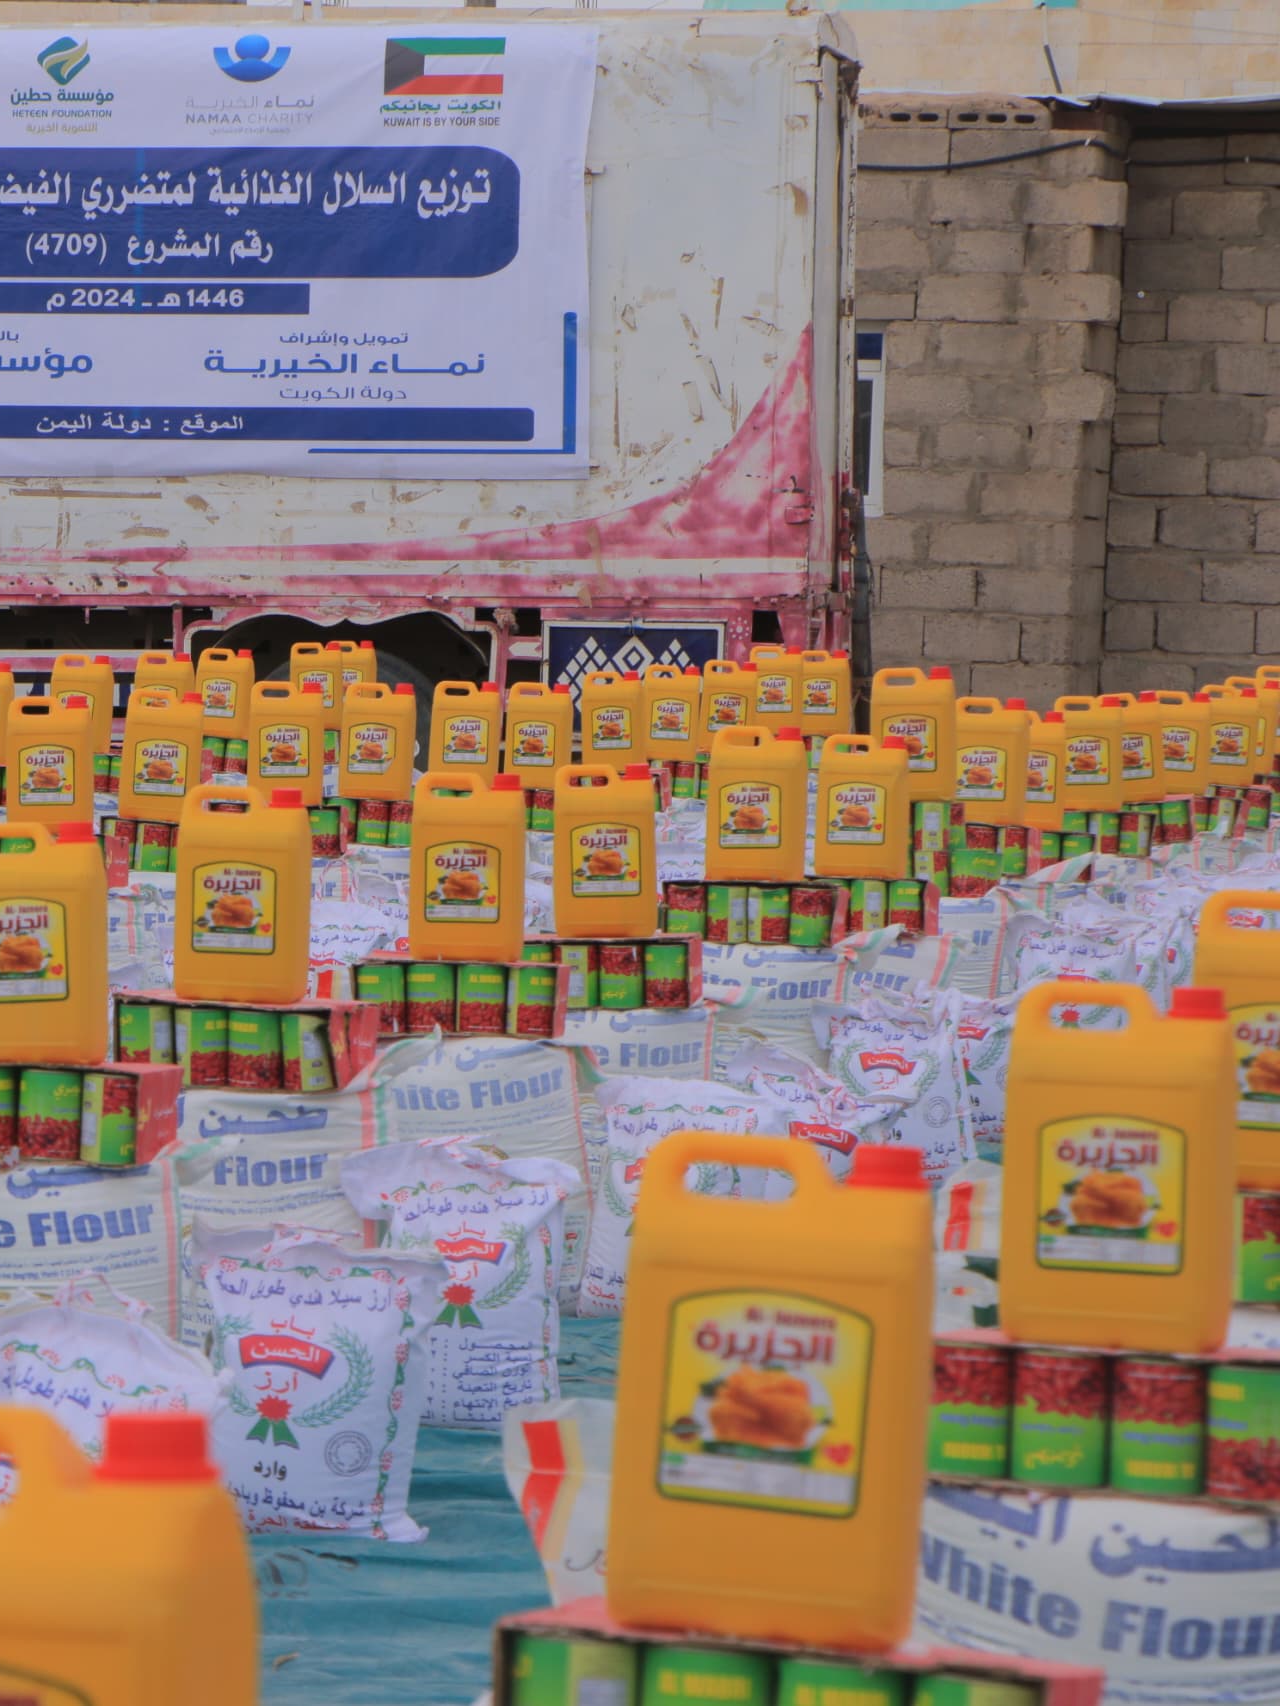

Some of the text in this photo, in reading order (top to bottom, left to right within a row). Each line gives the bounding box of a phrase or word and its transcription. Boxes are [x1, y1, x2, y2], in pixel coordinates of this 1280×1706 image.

[10, 87, 115, 106] مؤسسة حطين
[379, 99, 501, 115] الكويت بجانبكم
[12, 109, 113, 118] HETEEN FOUNDATION
[185, 113, 313, 125] NAMAA CHARITY
[383, 116, 499, 127] KUWAIT IS BY YOUR SIDE
[81, 171, 196, 220] لمتضرري
[208, 167, 312, 216] الغذائية
[323, 171, 406, 215] السلال
[418, 168, 491, 219] توزيع
[26, 228, 273, 265] رقم المشروع (4709)
[46, 293, 66, 311] م
[71, 288, 136, 308] 2024
[186, 289, 244, 308] 1446
[279, 329, 409, 347] تمويل وإشراف
[203, 346, 485, 380] نماء الخيرية
[279, 385, 408, 402] دولة الكويت
[36, 413, 92, 434] اليمن
[101, 411, 152, 434] دولة
[180, 413, 244, 436] الموقع
[265, 731, 300, 744] الجزيرة
[26, 755, 65, 767] الجزيرة
[961, 755, 997, 766] الجزيرة
[726, 792, 770, 806] الجزيرة
[835, 792, 876, 804] الجزيرة
[579, 835, 628, 850] الجزيرة
[434, 855, 488, 870] الجزيرة
[203, 876, 261, 893] الجزيرة
[620, 1040, 703, 1068] Flour
[470, 1066, 566, 1110] Flour
[796, 1127, 849, 1145] الحسن
[1056, 1140, 1160, 1170] الجزيرة
[214, 1153, 328, 1187] Flour
[28, 1204, 154, 1248] Flour
[447, 1220, 486, 1240] باب
[327, 1288, 363, 1309] سيلا
[366, 1286, 392, 1312] أرز
[270, 1314, 317, 1340] باب
[249, 1342, 322, 1363] الحسن
[694, 1320, 837, 1367] الجزيرة
[253, 1371, 299, 1394] أرز
[253, 1460, 288, 1481] وارد
[262, 1487, 366, 1521] شركة بن محفوظ
